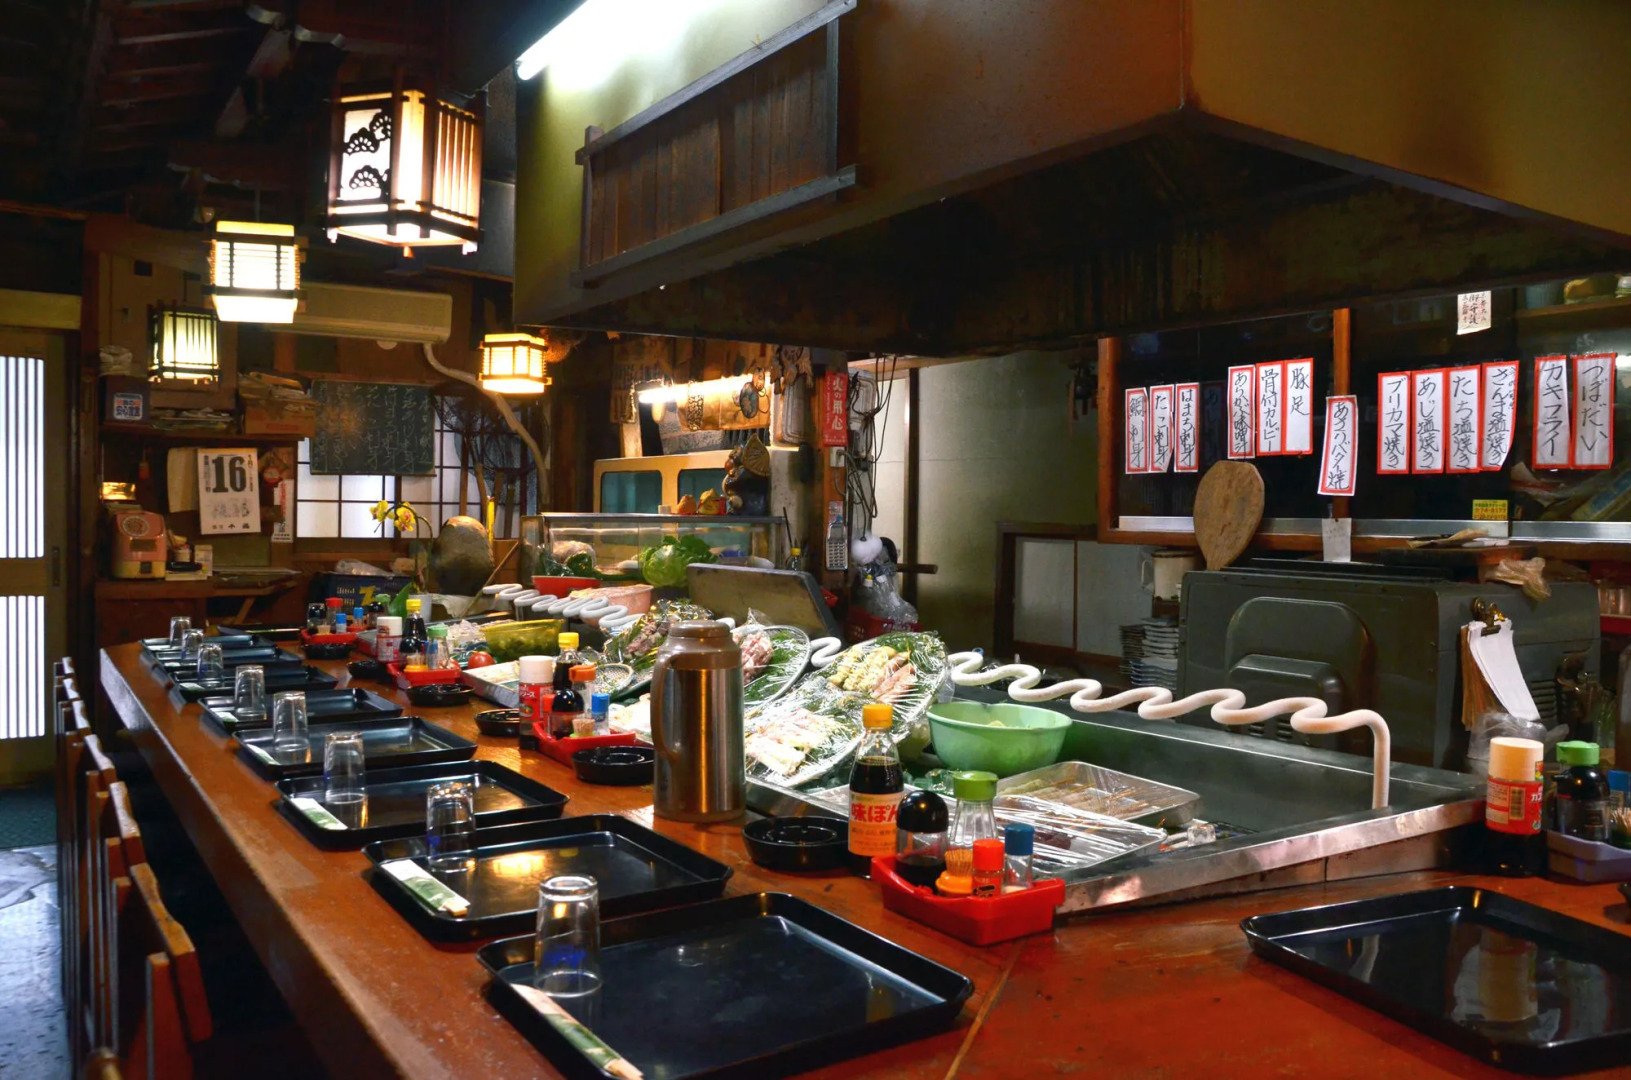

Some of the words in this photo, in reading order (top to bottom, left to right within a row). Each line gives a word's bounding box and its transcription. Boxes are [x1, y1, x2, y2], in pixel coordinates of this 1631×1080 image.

[832, 376, 844, 431] 火の用心
[1154, 394, 1169, 466] たこ刺身
[1180, 388, 1196, 468] はまち刺身
[1261, 368, 1280, 452] 骨付カルビー
[1290, 366, 1310, 416] 豚足
[1384, 377, 1406, 469] ブリカマ焼き
[1417, 377, 1440, 469] あじ塩焼き
[1452, 375, 1477, 469] たち塩焼き
[1542, 364, 1563, 457] カキフライ
[212, 455, 247, 493] 16
